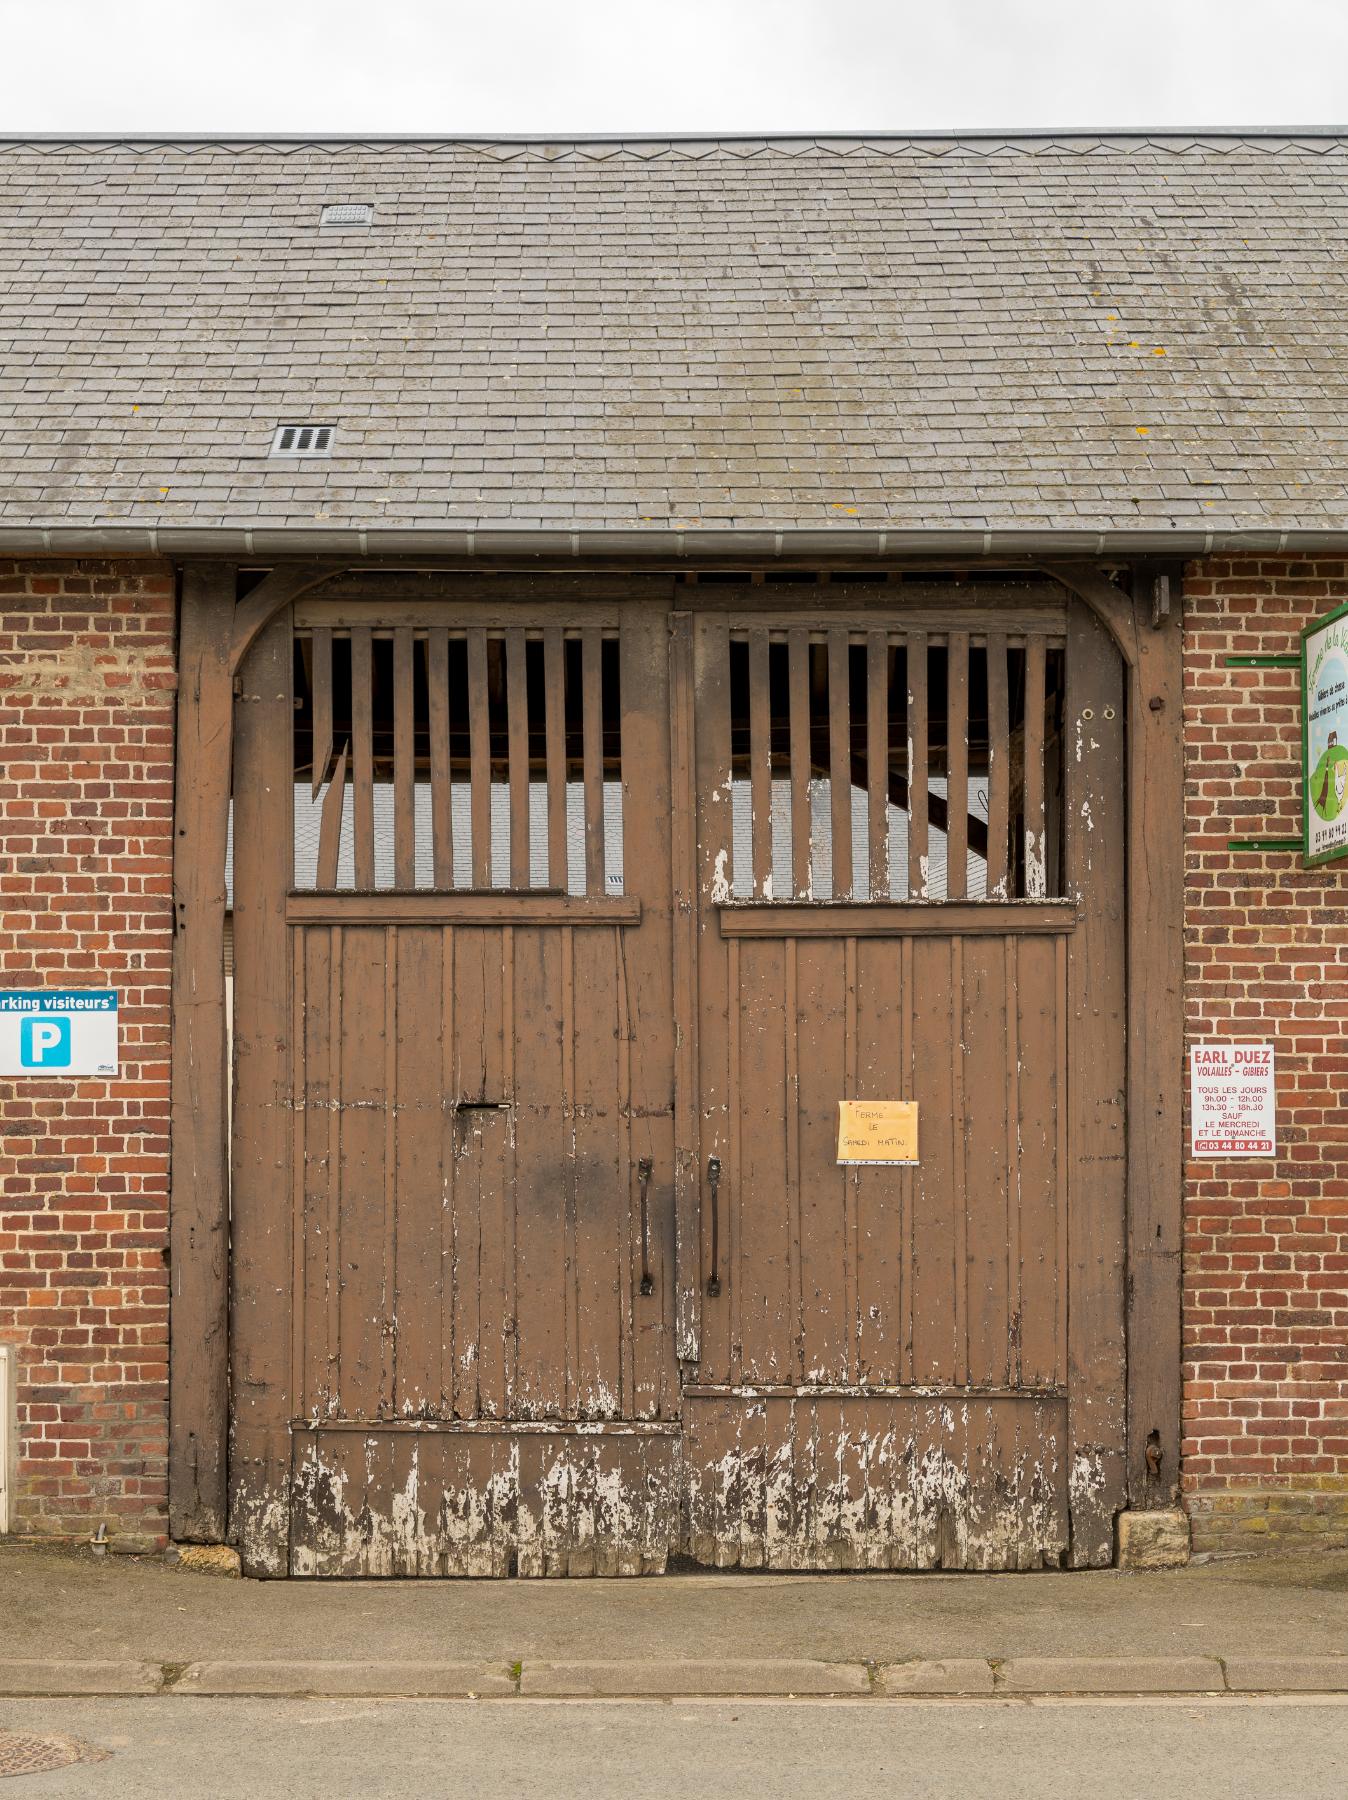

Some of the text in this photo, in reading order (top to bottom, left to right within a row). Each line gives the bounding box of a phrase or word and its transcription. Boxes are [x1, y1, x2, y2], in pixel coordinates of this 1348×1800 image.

[0, 997, 110, 1011] rking visiteurs
[32, 1022, 61, 1063] P
[1194, 1050, 1271, 1064] EARL DUEZ
[1197, 1066, 1232, 1077] VOLAILLES
[1242, 1066, 1269, 1077] GIBIERS
[1198, 1086, 1268, 1094] TOUS LES JOURS
[1204, 1095, 1227, 1103] 9h.00
[1238, 1095, 1263, 1103] 12h.00
[1221, 1112, 1243, 1120] SAUF
[868, 1123, 879, 1131] LE
[1198, 1129, 1267, 1137] ET LE DIMANCHE
[842, 1135, 870, 1147] SAMEDI
[1208, 1141, 1269, 1150] 03 44 80 44 21
